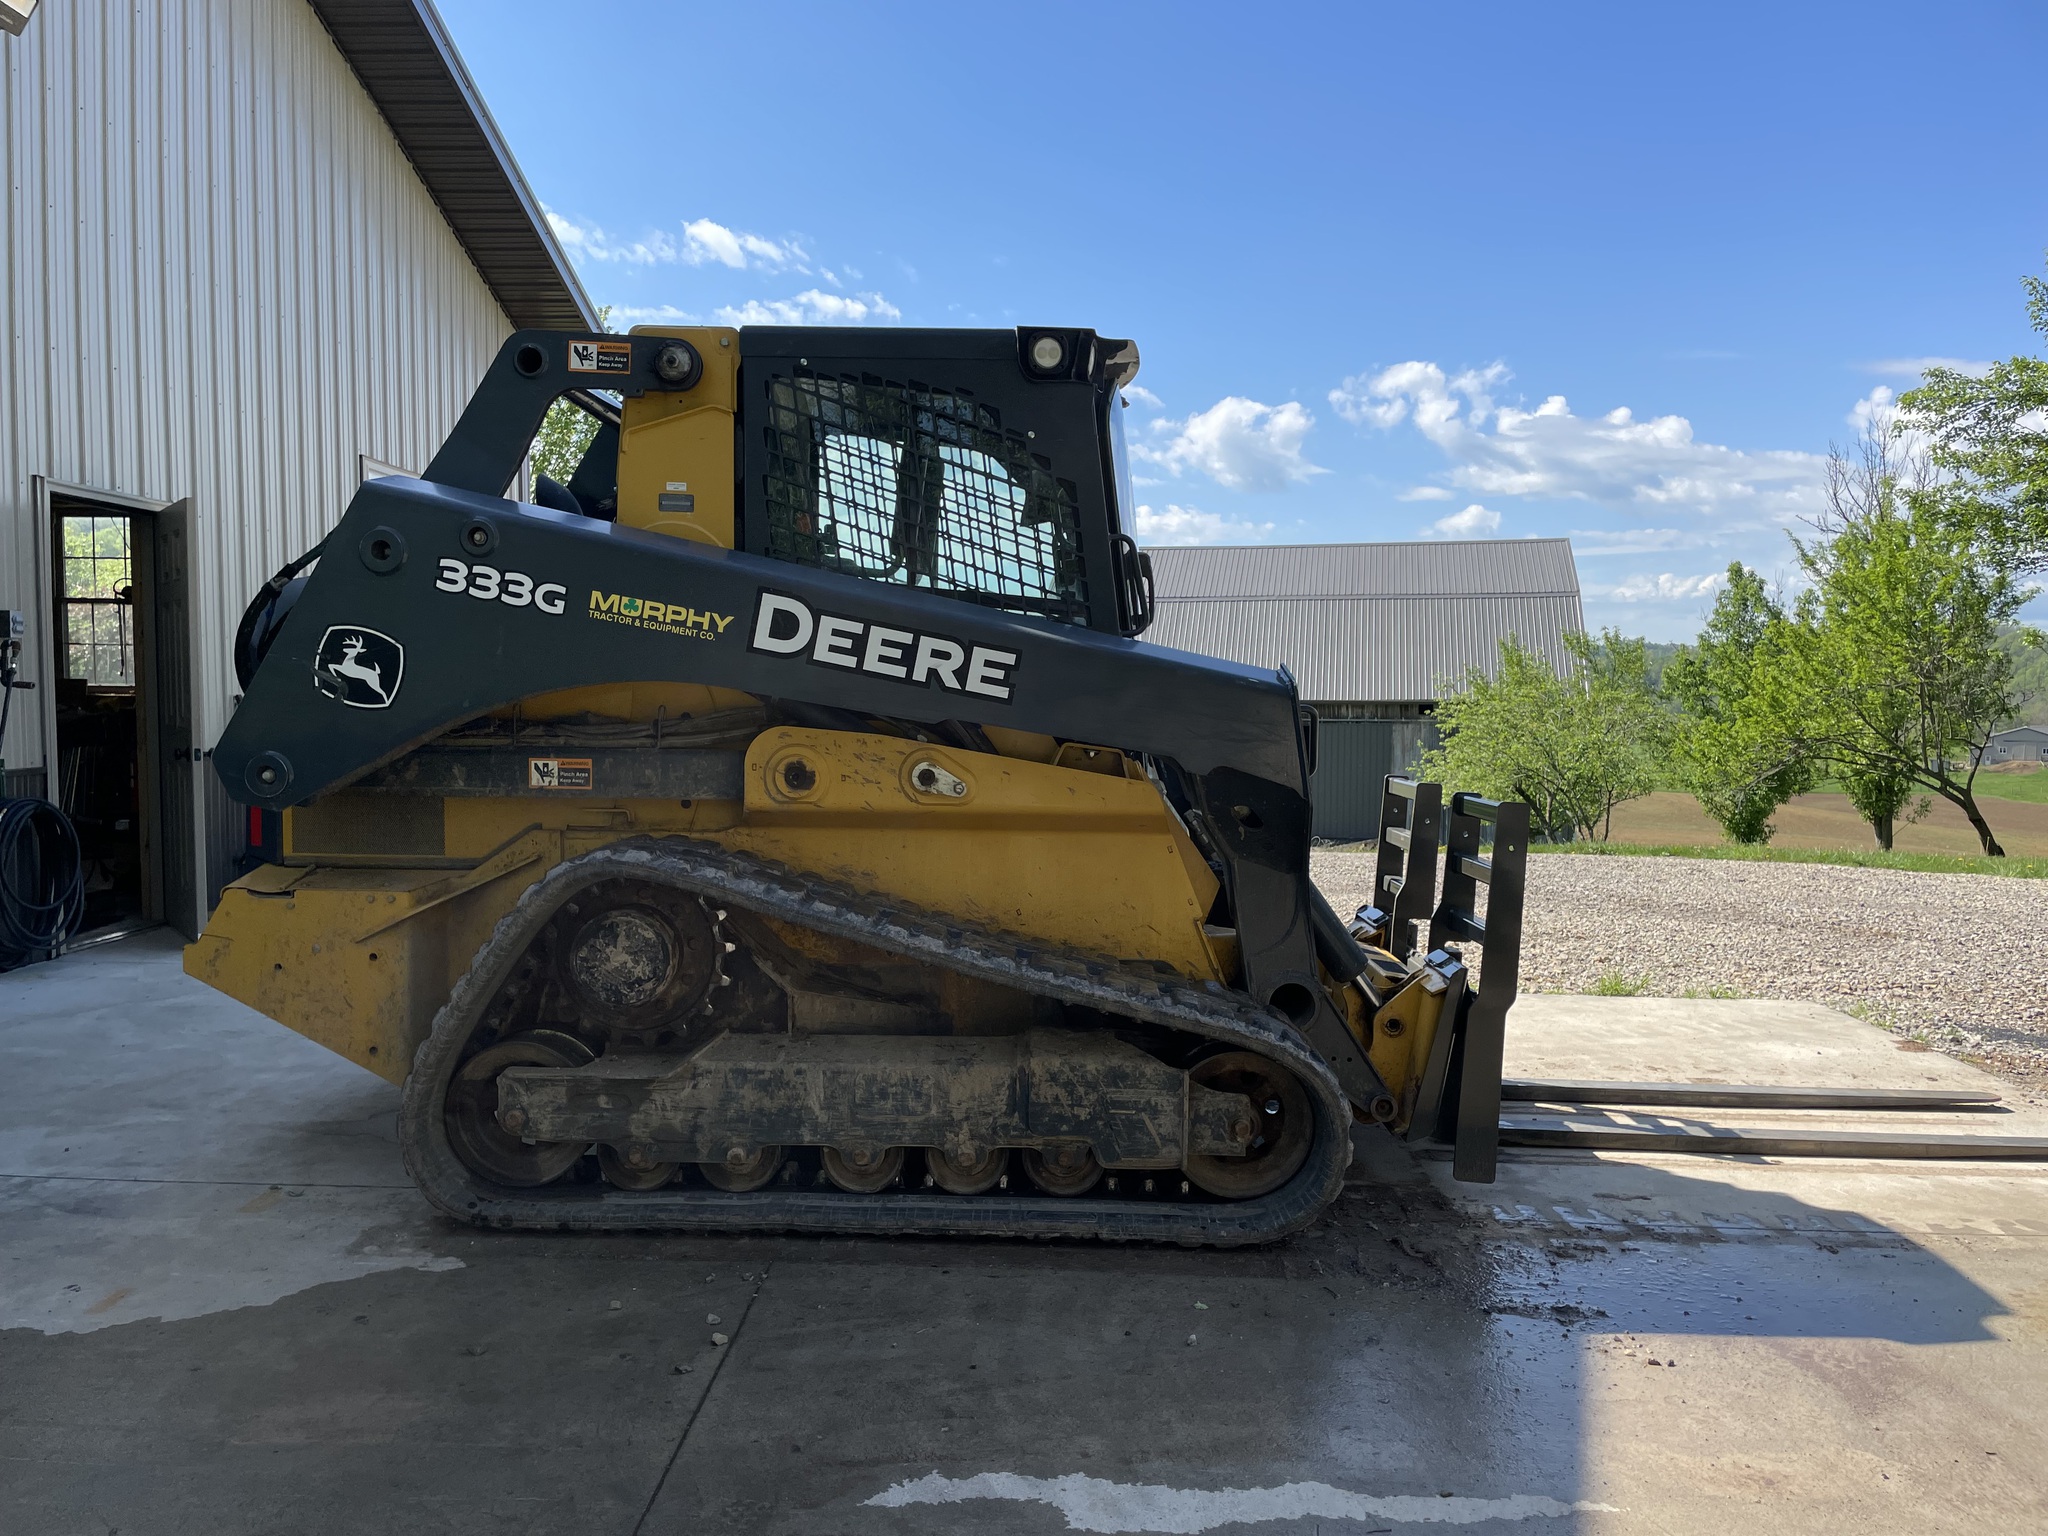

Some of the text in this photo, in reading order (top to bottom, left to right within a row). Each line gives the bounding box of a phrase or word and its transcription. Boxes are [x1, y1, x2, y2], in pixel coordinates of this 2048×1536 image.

[435, 557, 568, 616] 333G
[589, 590, 735, 633] MURPHY
[588, 609, 716, 641] TRACTOR & EQUIPMENT CO.
[752, 591, 1018, 700] DEERE
